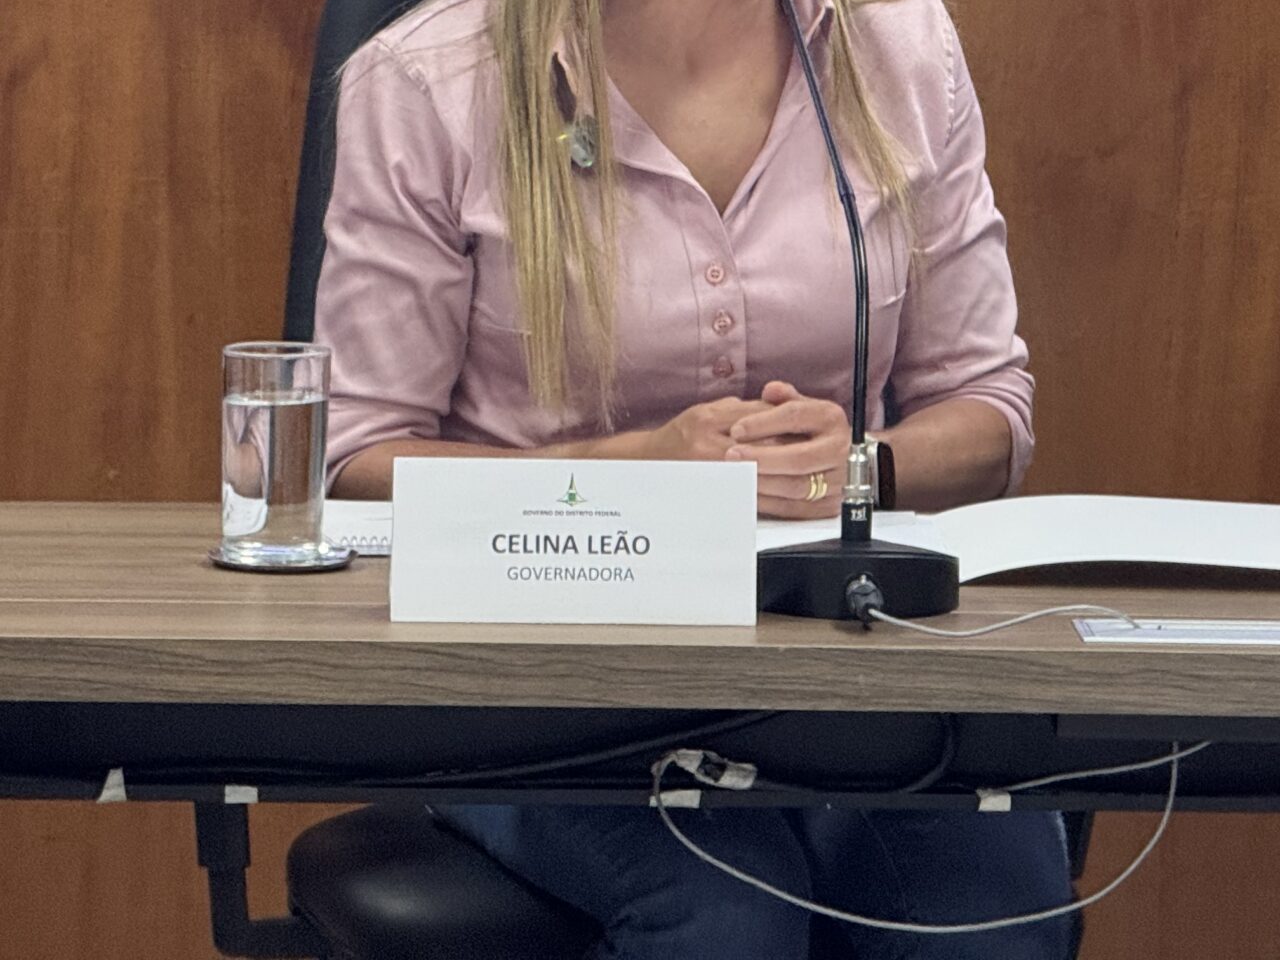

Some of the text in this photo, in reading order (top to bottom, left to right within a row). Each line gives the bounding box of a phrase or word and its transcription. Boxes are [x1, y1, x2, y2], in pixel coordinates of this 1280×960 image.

[491, 530, 651, 556] CELINA LEÃO
[506, 566, 636, 582] GOVERNADORA
